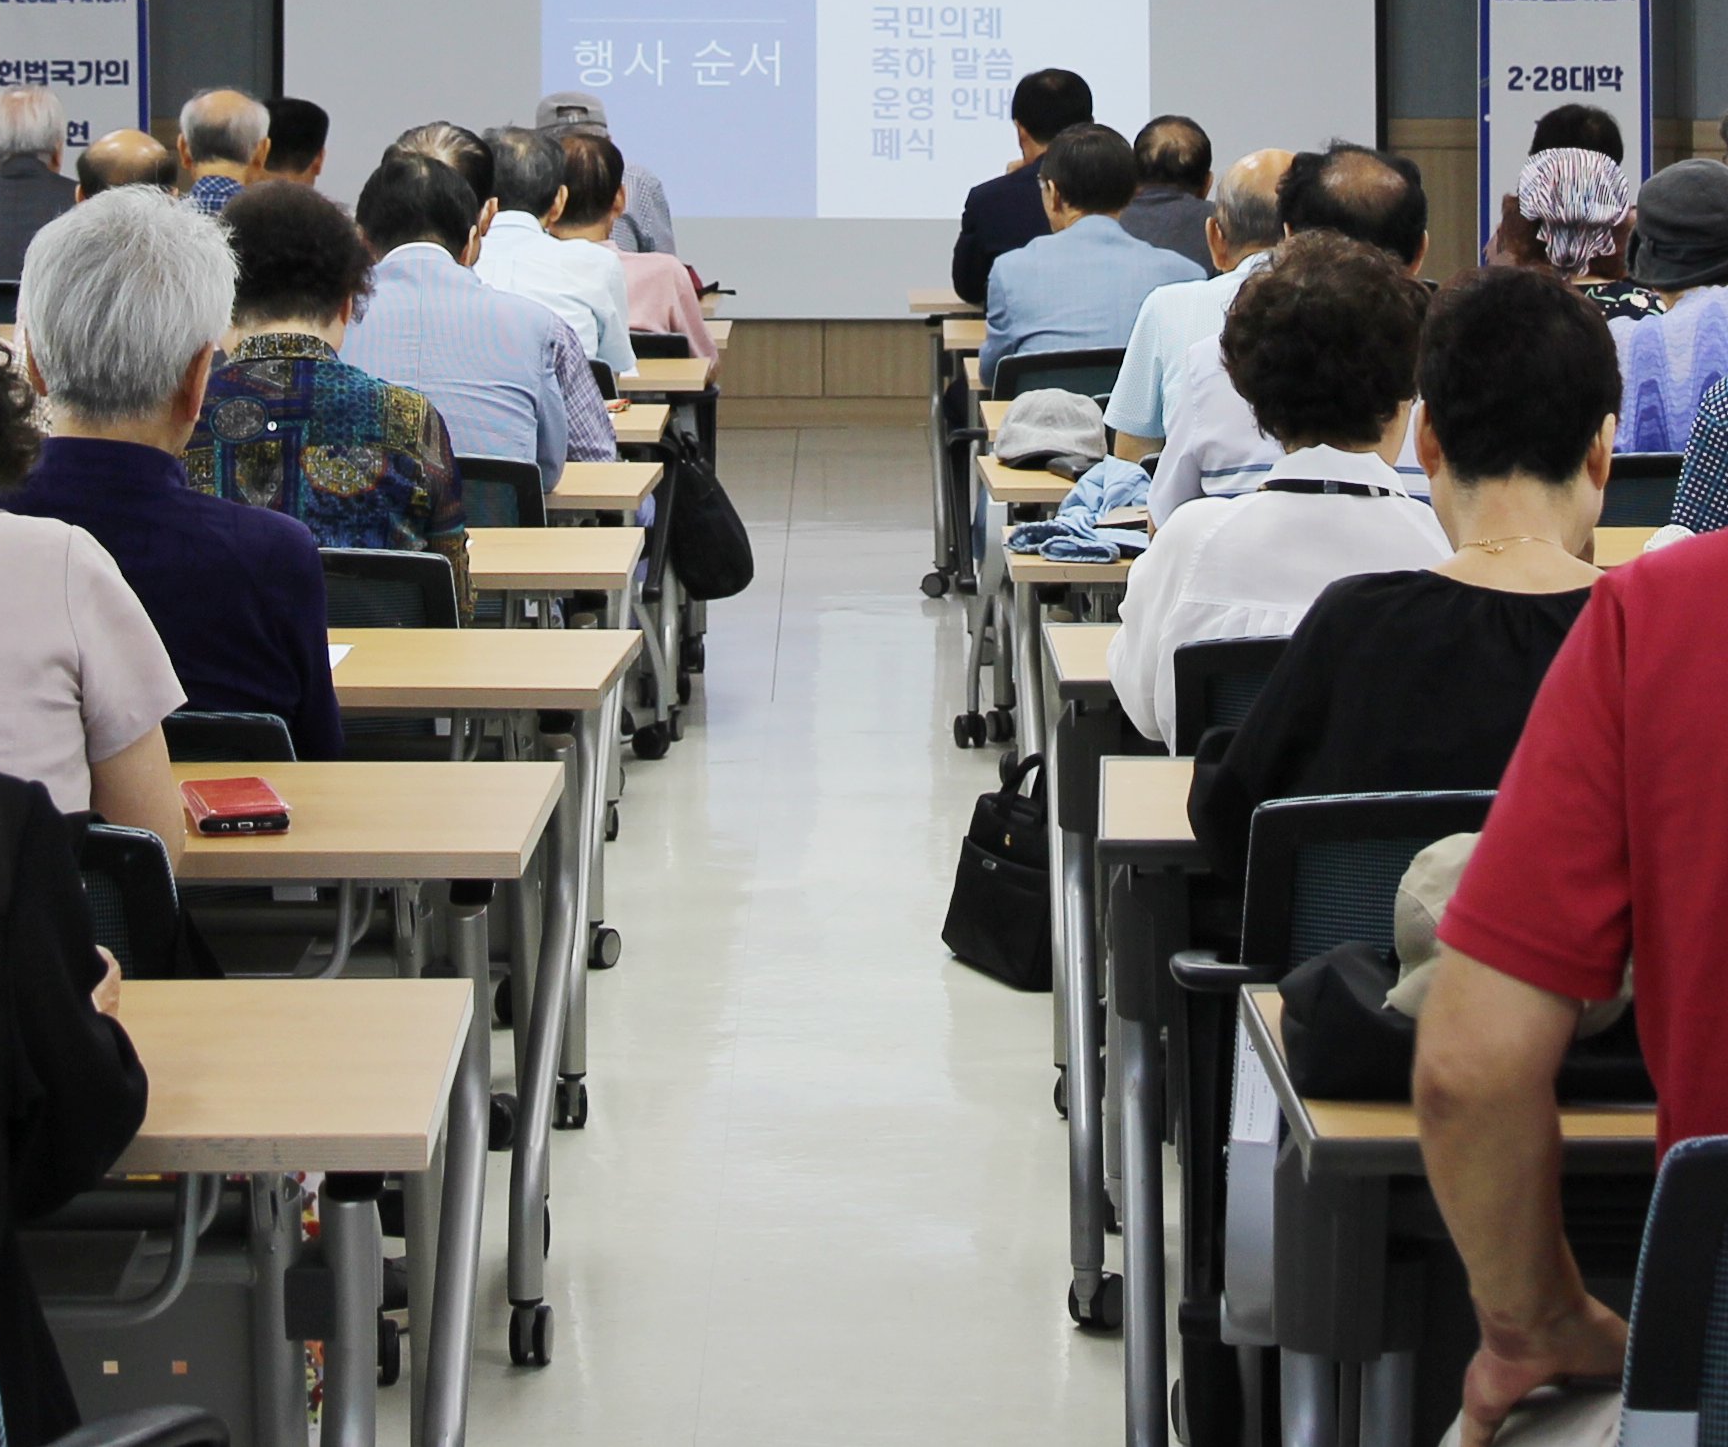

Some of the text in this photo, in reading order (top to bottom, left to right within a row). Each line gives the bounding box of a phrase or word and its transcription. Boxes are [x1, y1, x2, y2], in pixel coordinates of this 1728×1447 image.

[871, 6, 1002, 40] 국민의례
[573, 40, 781, 87] 행사 순서
[871, 46, 1014, 81] 축하 말씀
[1507, 64, 1625, 93] 2·28대학
[871, 86, 1012, 121] 운영 안내
[871, 127, 934, 161] 폐식
